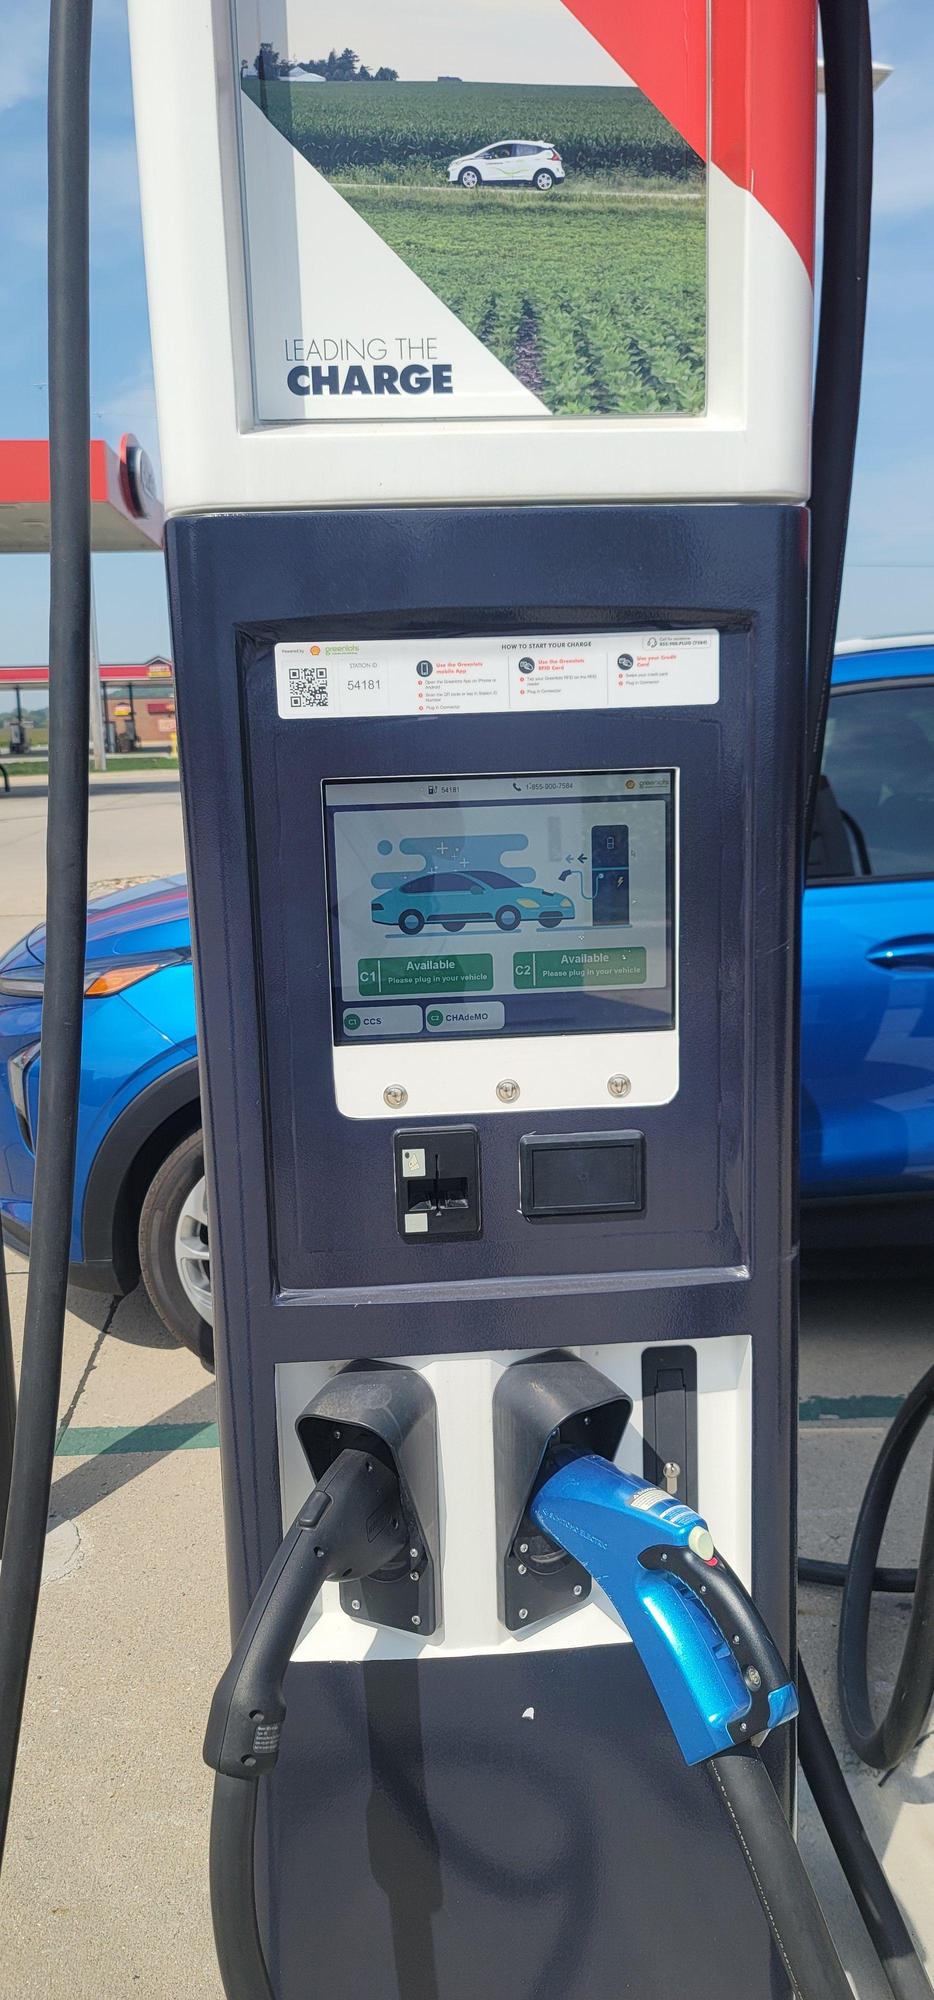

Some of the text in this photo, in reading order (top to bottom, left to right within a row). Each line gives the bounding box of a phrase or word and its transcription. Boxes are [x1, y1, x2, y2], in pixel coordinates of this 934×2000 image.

[285, 338, 438, 362] LEADING THE
[287, 364, 453, 396] CHARGE
[347, 680, 381, 691] 54181
[560, 952, 609, 965] Available
[406, 959, 455, 971] Available
[515, 965, 531, 976] C2
[360, 971, 376, 982] C1
[569, 968, 585, 978] plug
[595, 968, 612, 976] your
[614, 966, 640, 975] vehicle
[388, 976, 413, 984] Please
[414, 974, 432, 984] plug
[442, 974, 459, 983] your
[460, 973, 488, 982] vehicle
[445, 1012, 489, 1022] CHAdeMO
